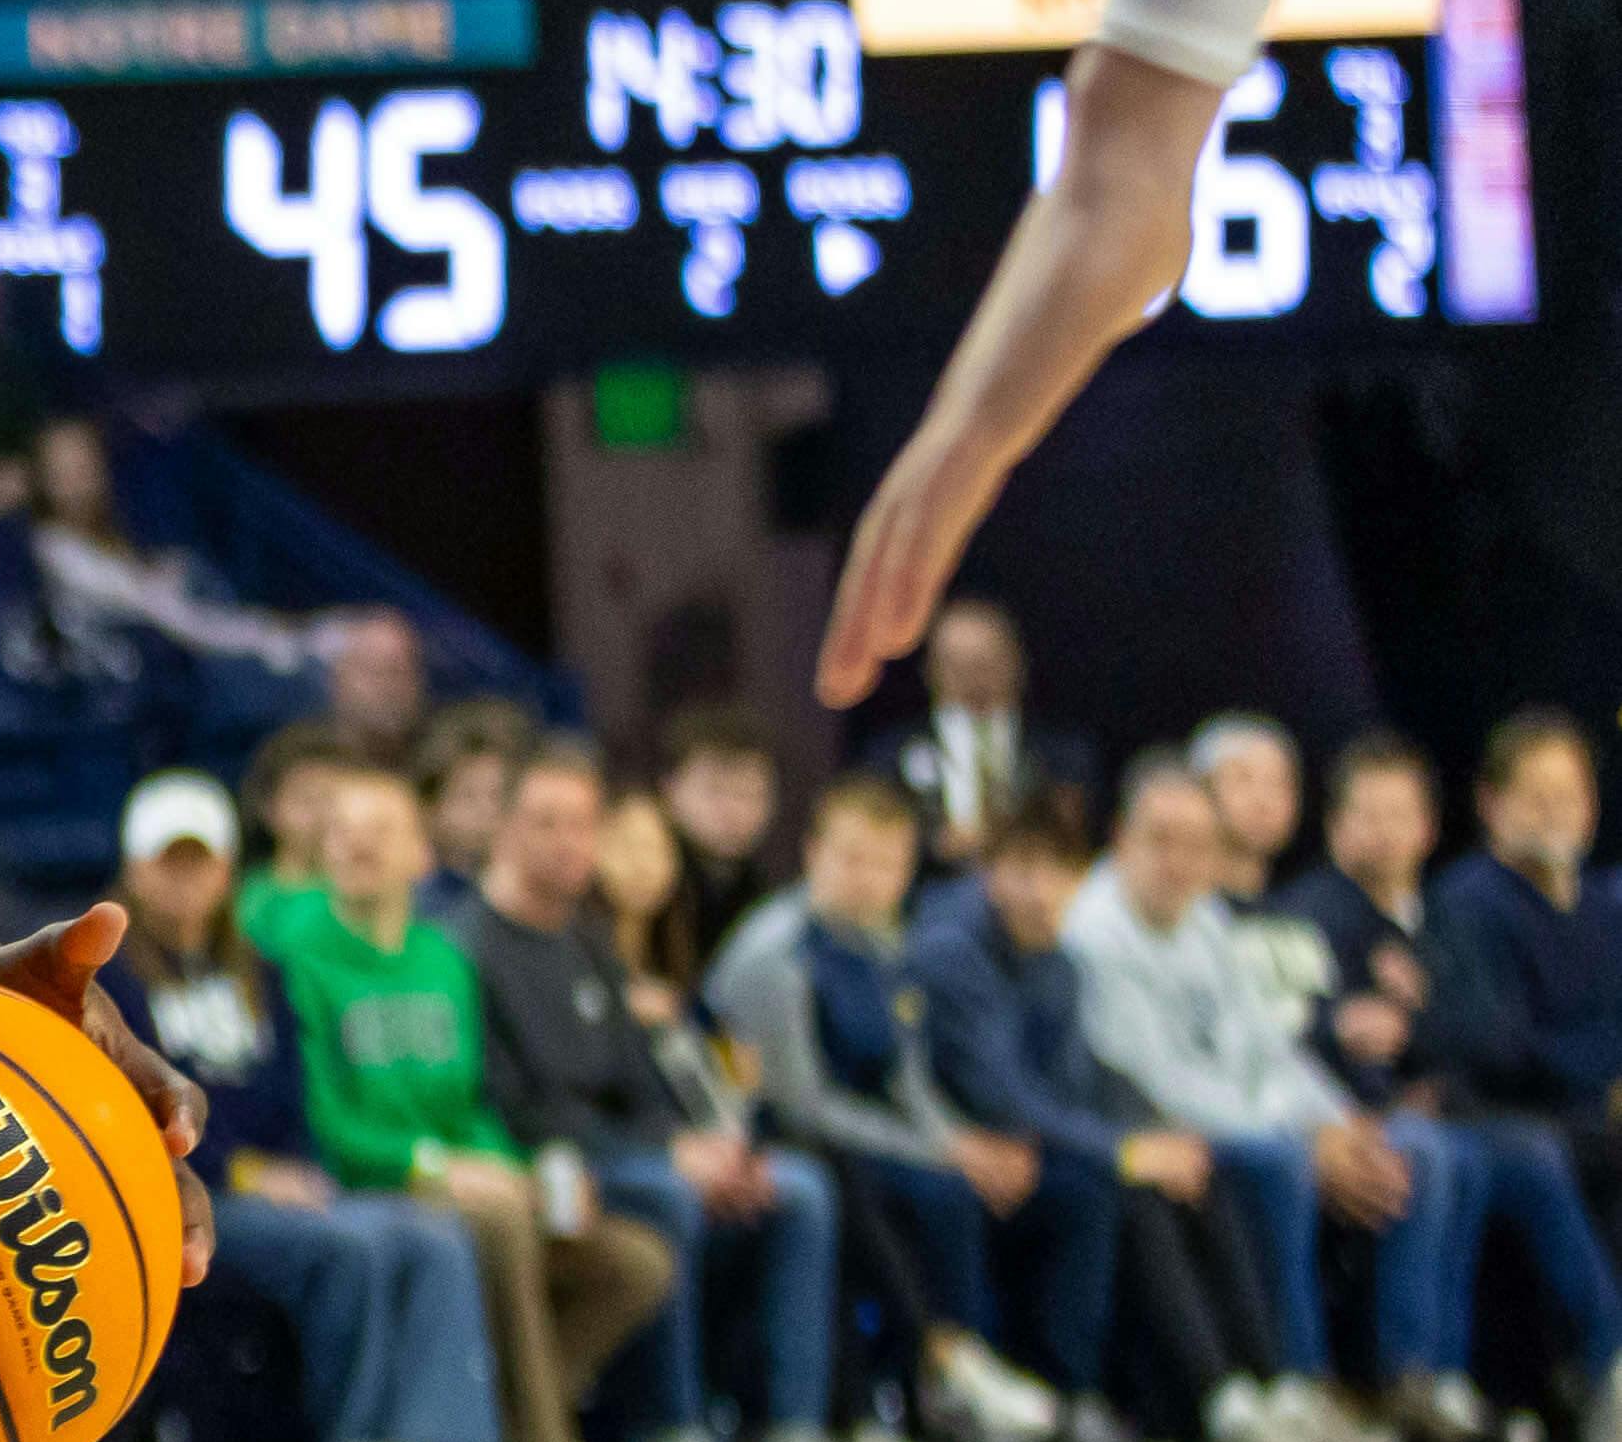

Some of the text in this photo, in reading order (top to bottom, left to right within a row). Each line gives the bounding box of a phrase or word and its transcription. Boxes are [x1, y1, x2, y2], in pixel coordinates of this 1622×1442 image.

[586, 0, 862, 152] 14:30
[1033, 58, 1311, 320] 6
[224, 89, 508, 352] 45
